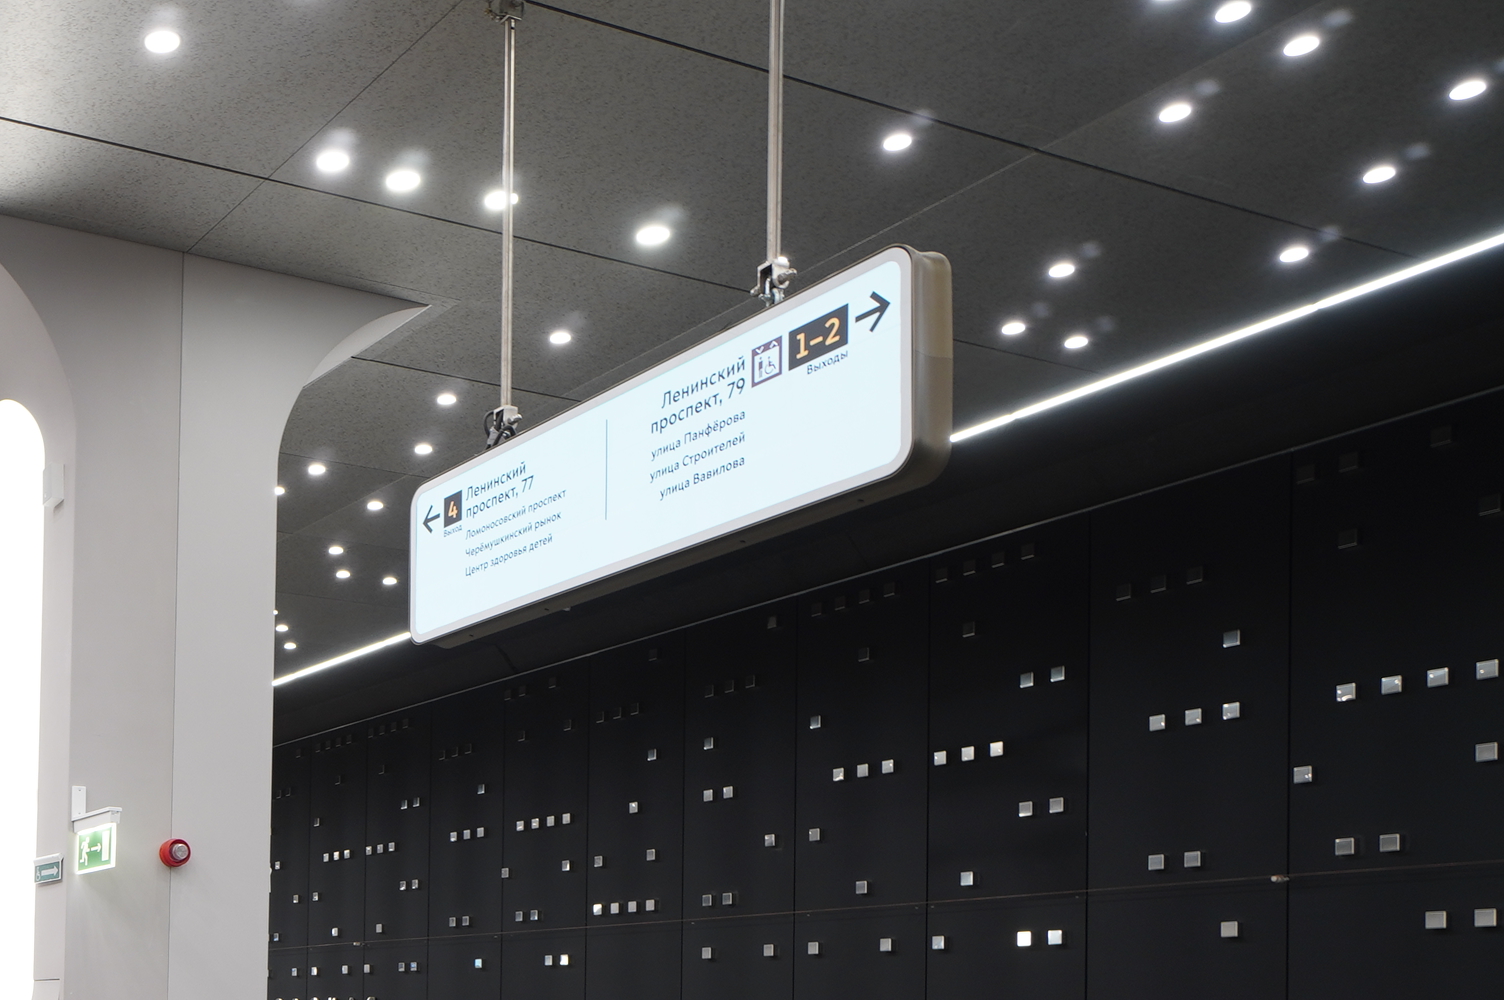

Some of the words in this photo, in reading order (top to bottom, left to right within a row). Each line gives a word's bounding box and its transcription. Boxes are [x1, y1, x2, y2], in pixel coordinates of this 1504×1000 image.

[661, 356, 746, 409] Ленинский
[807, 350, 848, 375] Выходы
[651, 392, 723, 434] проспект,
[727, 377, 746, 400] 79
[649, 461, 680, 484] улица
[682, 431, 746, 467] Строителей
[651, 438, 681, 462] улица
[684, 410, 746, 445] Панфёрова
[465, 461, 527, 501] Ленинский
[466, 487, 519, 519] проспект,
[521, 475, 534, 493] 77
[659, 478, 690, 501] улица
[693, 457, 745, 485] Вавилова
[443, 525, 463, 538] Выход
[447, 501, 458, 519] 4
[465, 506, 527, 540] Ломоносовский
[528, 489, 567, 513] проспект
[465, 522, 533, 557] Черёмушкинский
[534, 512, 562, 532] рынок
[465, 561, 489, 577] Центр
[490, 545, 528, 567] здоровья
[528, 533, 553, 553] детей
